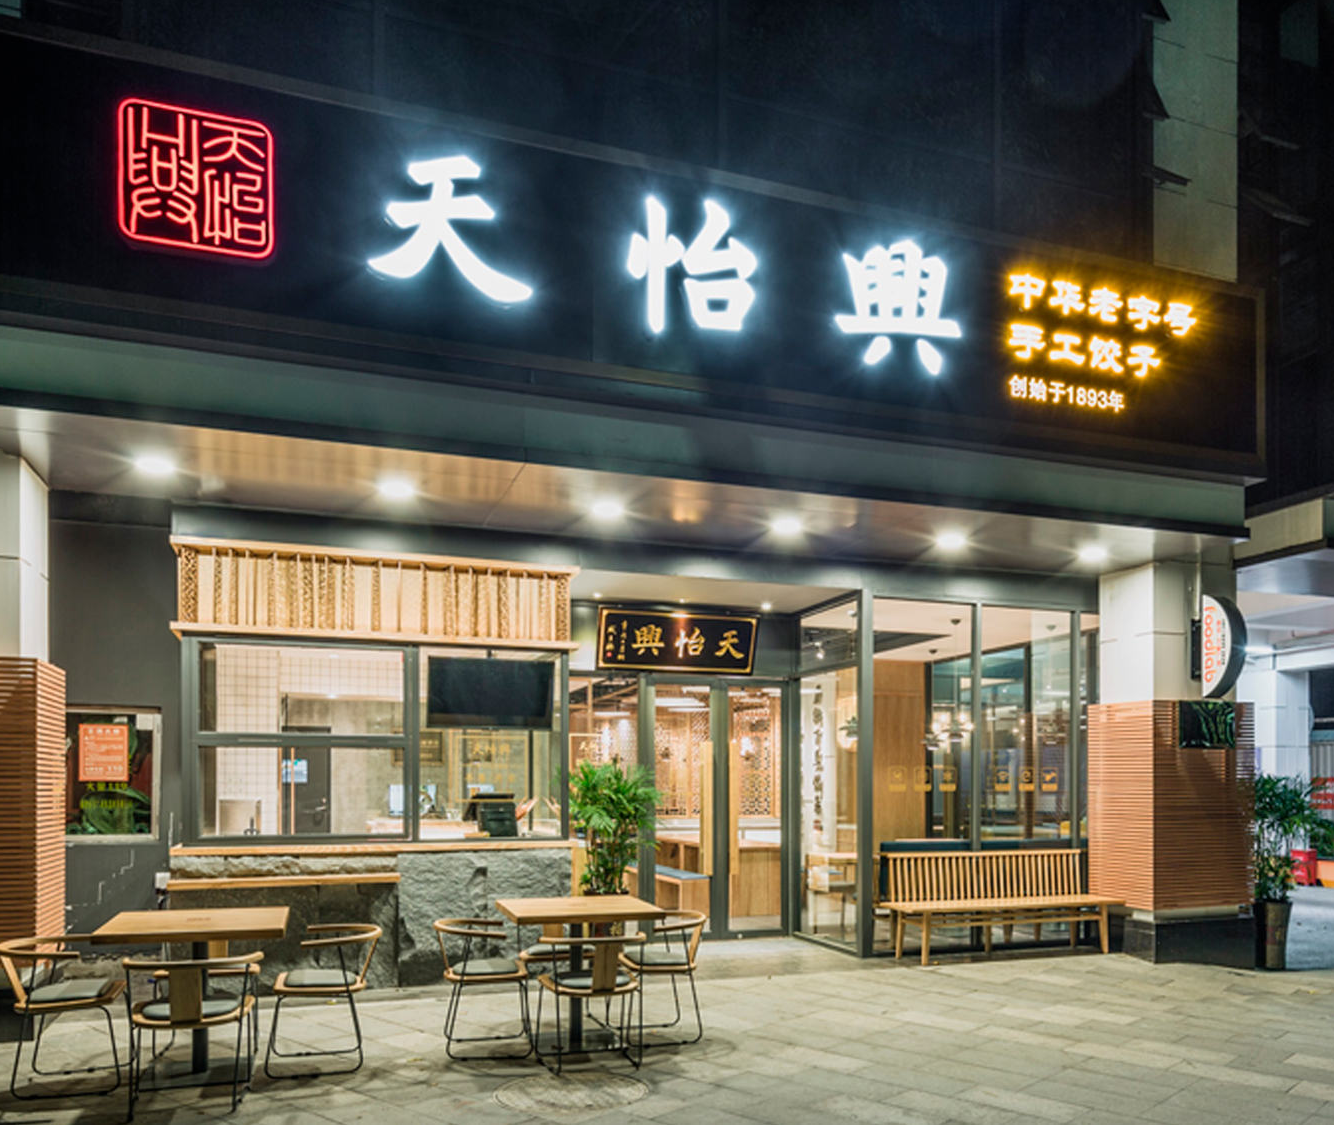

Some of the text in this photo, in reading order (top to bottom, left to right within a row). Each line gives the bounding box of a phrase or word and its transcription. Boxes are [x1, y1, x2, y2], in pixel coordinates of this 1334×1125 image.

[1007, 268, 1198, 339] 中华老字号
[1007, 320, 1163, 379] 手工饺子
[1007, 374, 1126, 415] 创始于1893年
